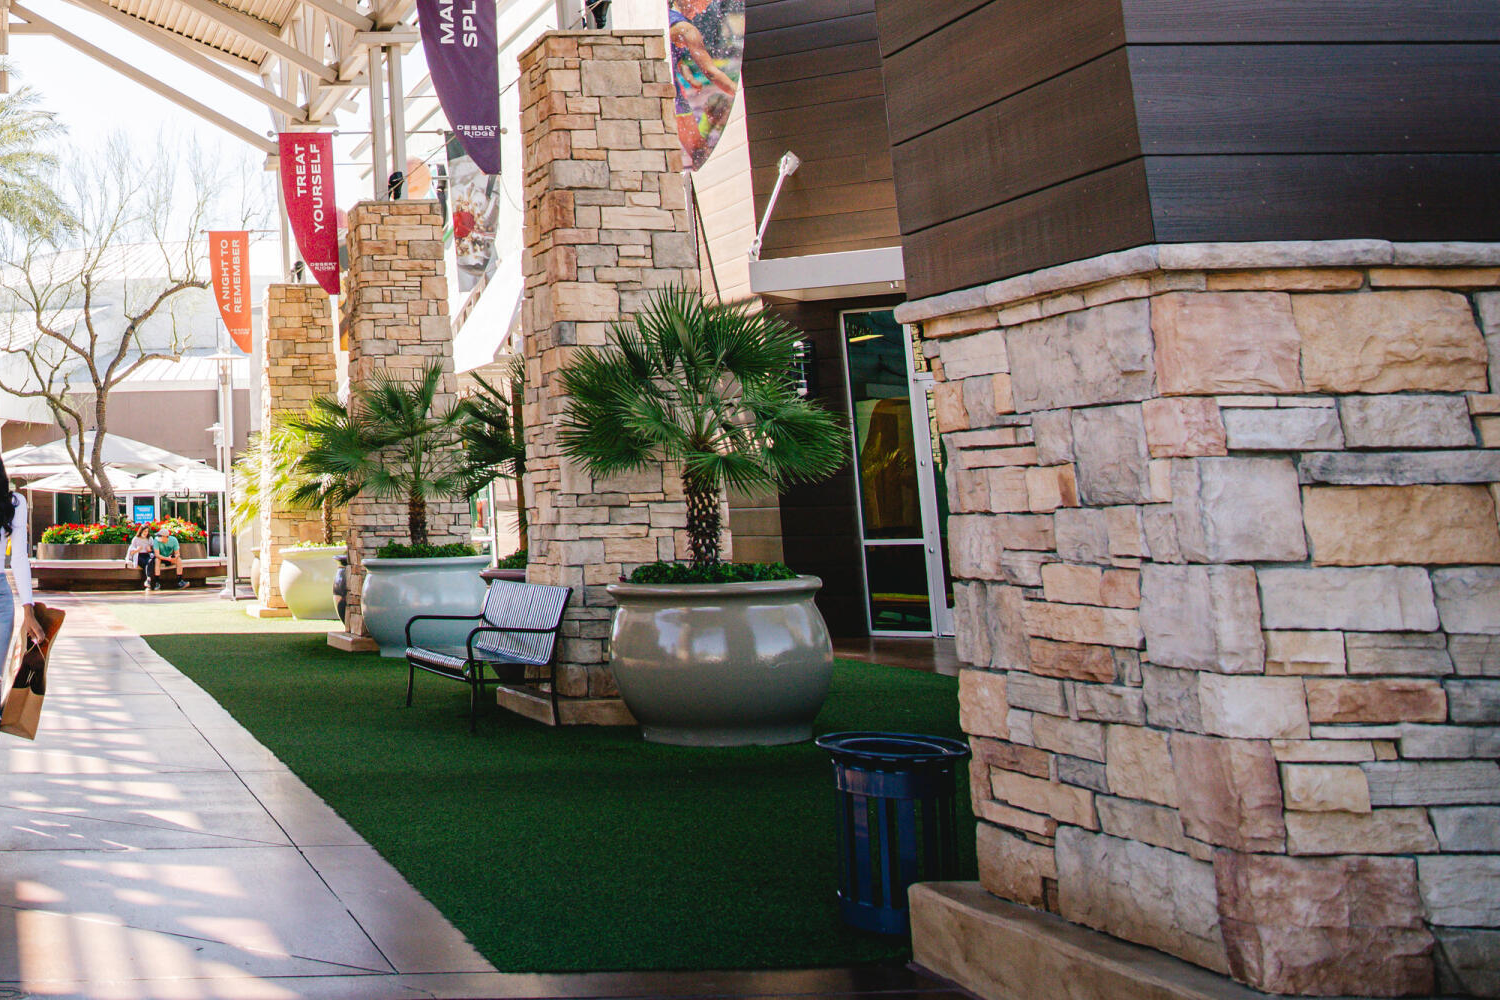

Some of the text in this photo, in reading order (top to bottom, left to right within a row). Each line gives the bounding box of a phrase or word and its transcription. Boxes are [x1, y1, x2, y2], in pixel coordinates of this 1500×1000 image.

[456, 124, 498, 132] DESERT
[463, 130, 496, 139] RIDGE
[294, 143, 307, 198] TREAT
[310, 143, 325, 233] YOURSELF
[220, 239, 231, 313] A NIGHT TO
[231, 240, 242, 313] REMEMBER
